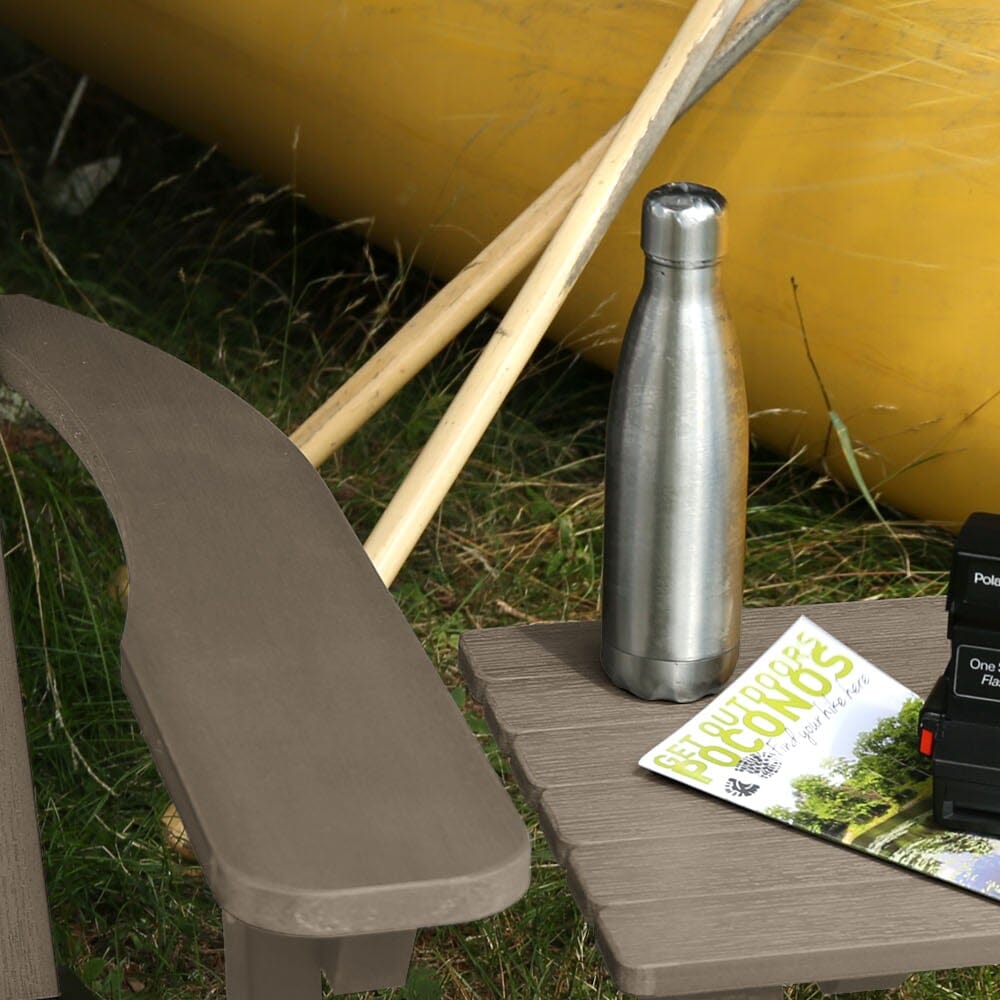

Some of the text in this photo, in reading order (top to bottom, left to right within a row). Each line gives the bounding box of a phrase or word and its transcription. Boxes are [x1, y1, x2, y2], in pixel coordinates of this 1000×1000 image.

[969, 657, 996, 673] One
[671, 641, 854, 785] POCONOS
[800, 717, 823, 746] your
[653, 733, 701, 770] GET
